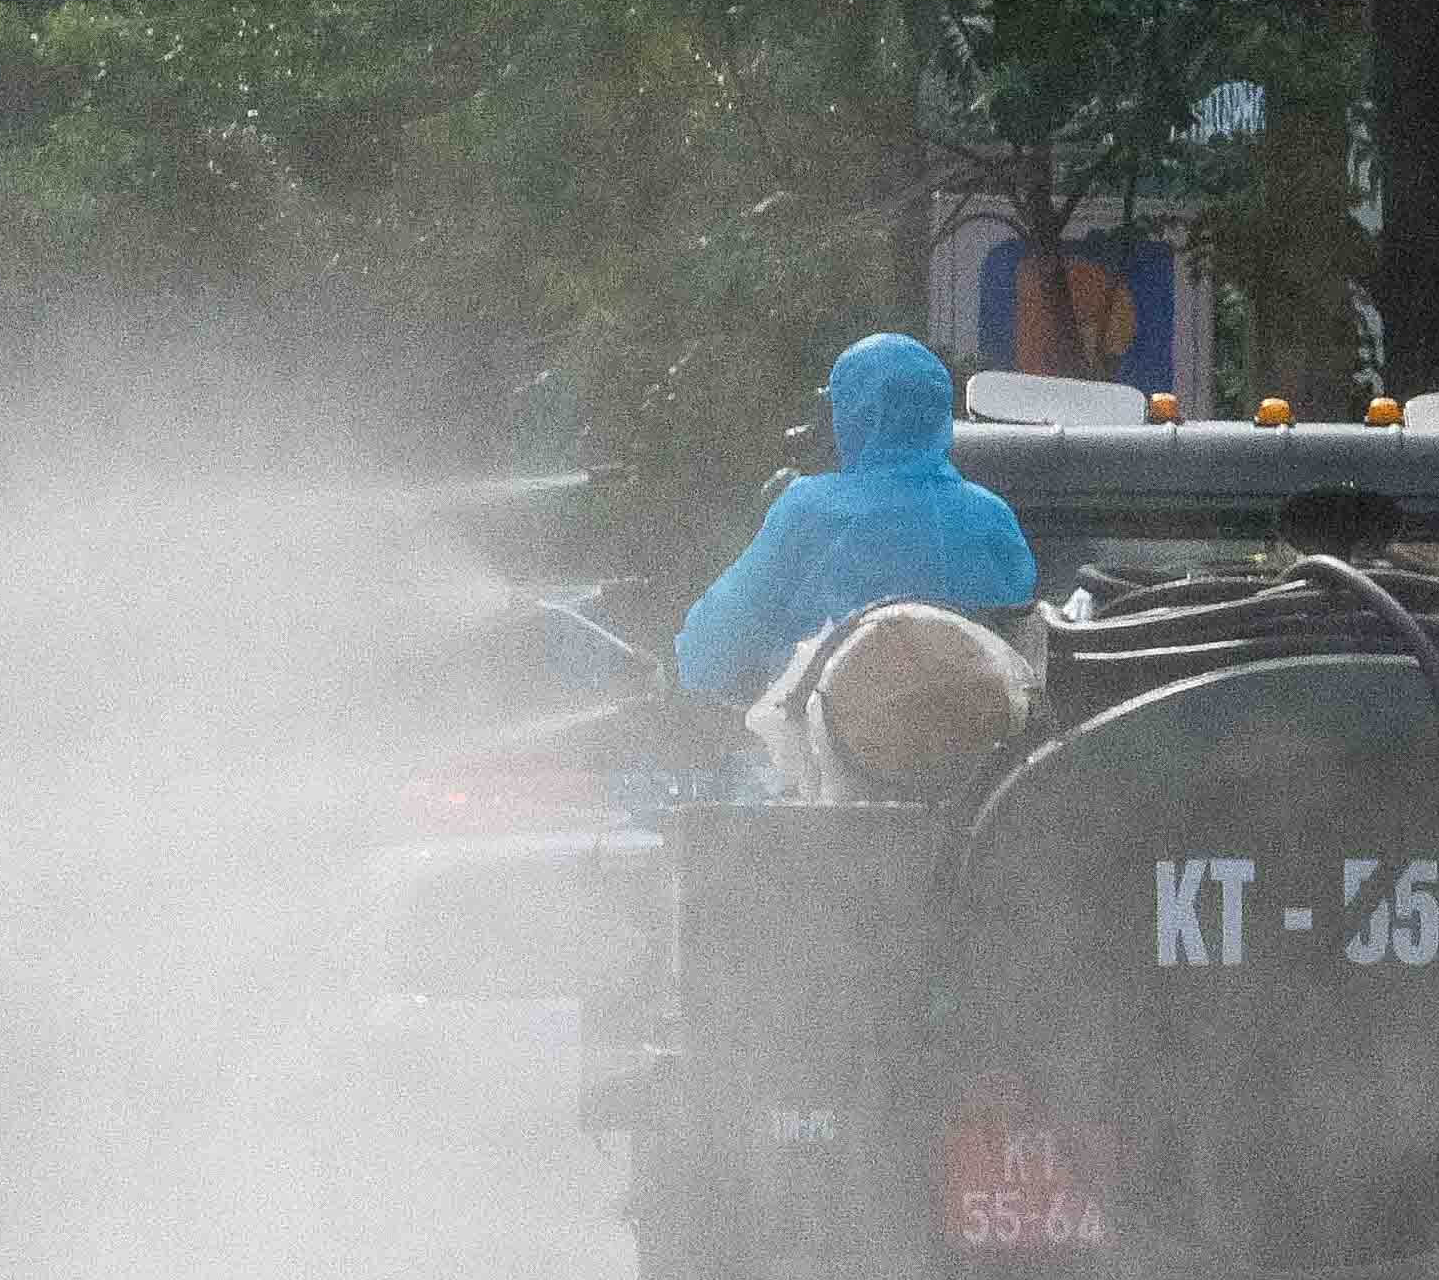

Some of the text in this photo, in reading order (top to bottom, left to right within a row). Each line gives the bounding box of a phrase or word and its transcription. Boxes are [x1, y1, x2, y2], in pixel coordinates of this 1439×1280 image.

[1156, 860, 1255, 966] KT
[1003, 1130, 1058, 1182] KT
[961, 1191, 1104, 1244] 55-64
